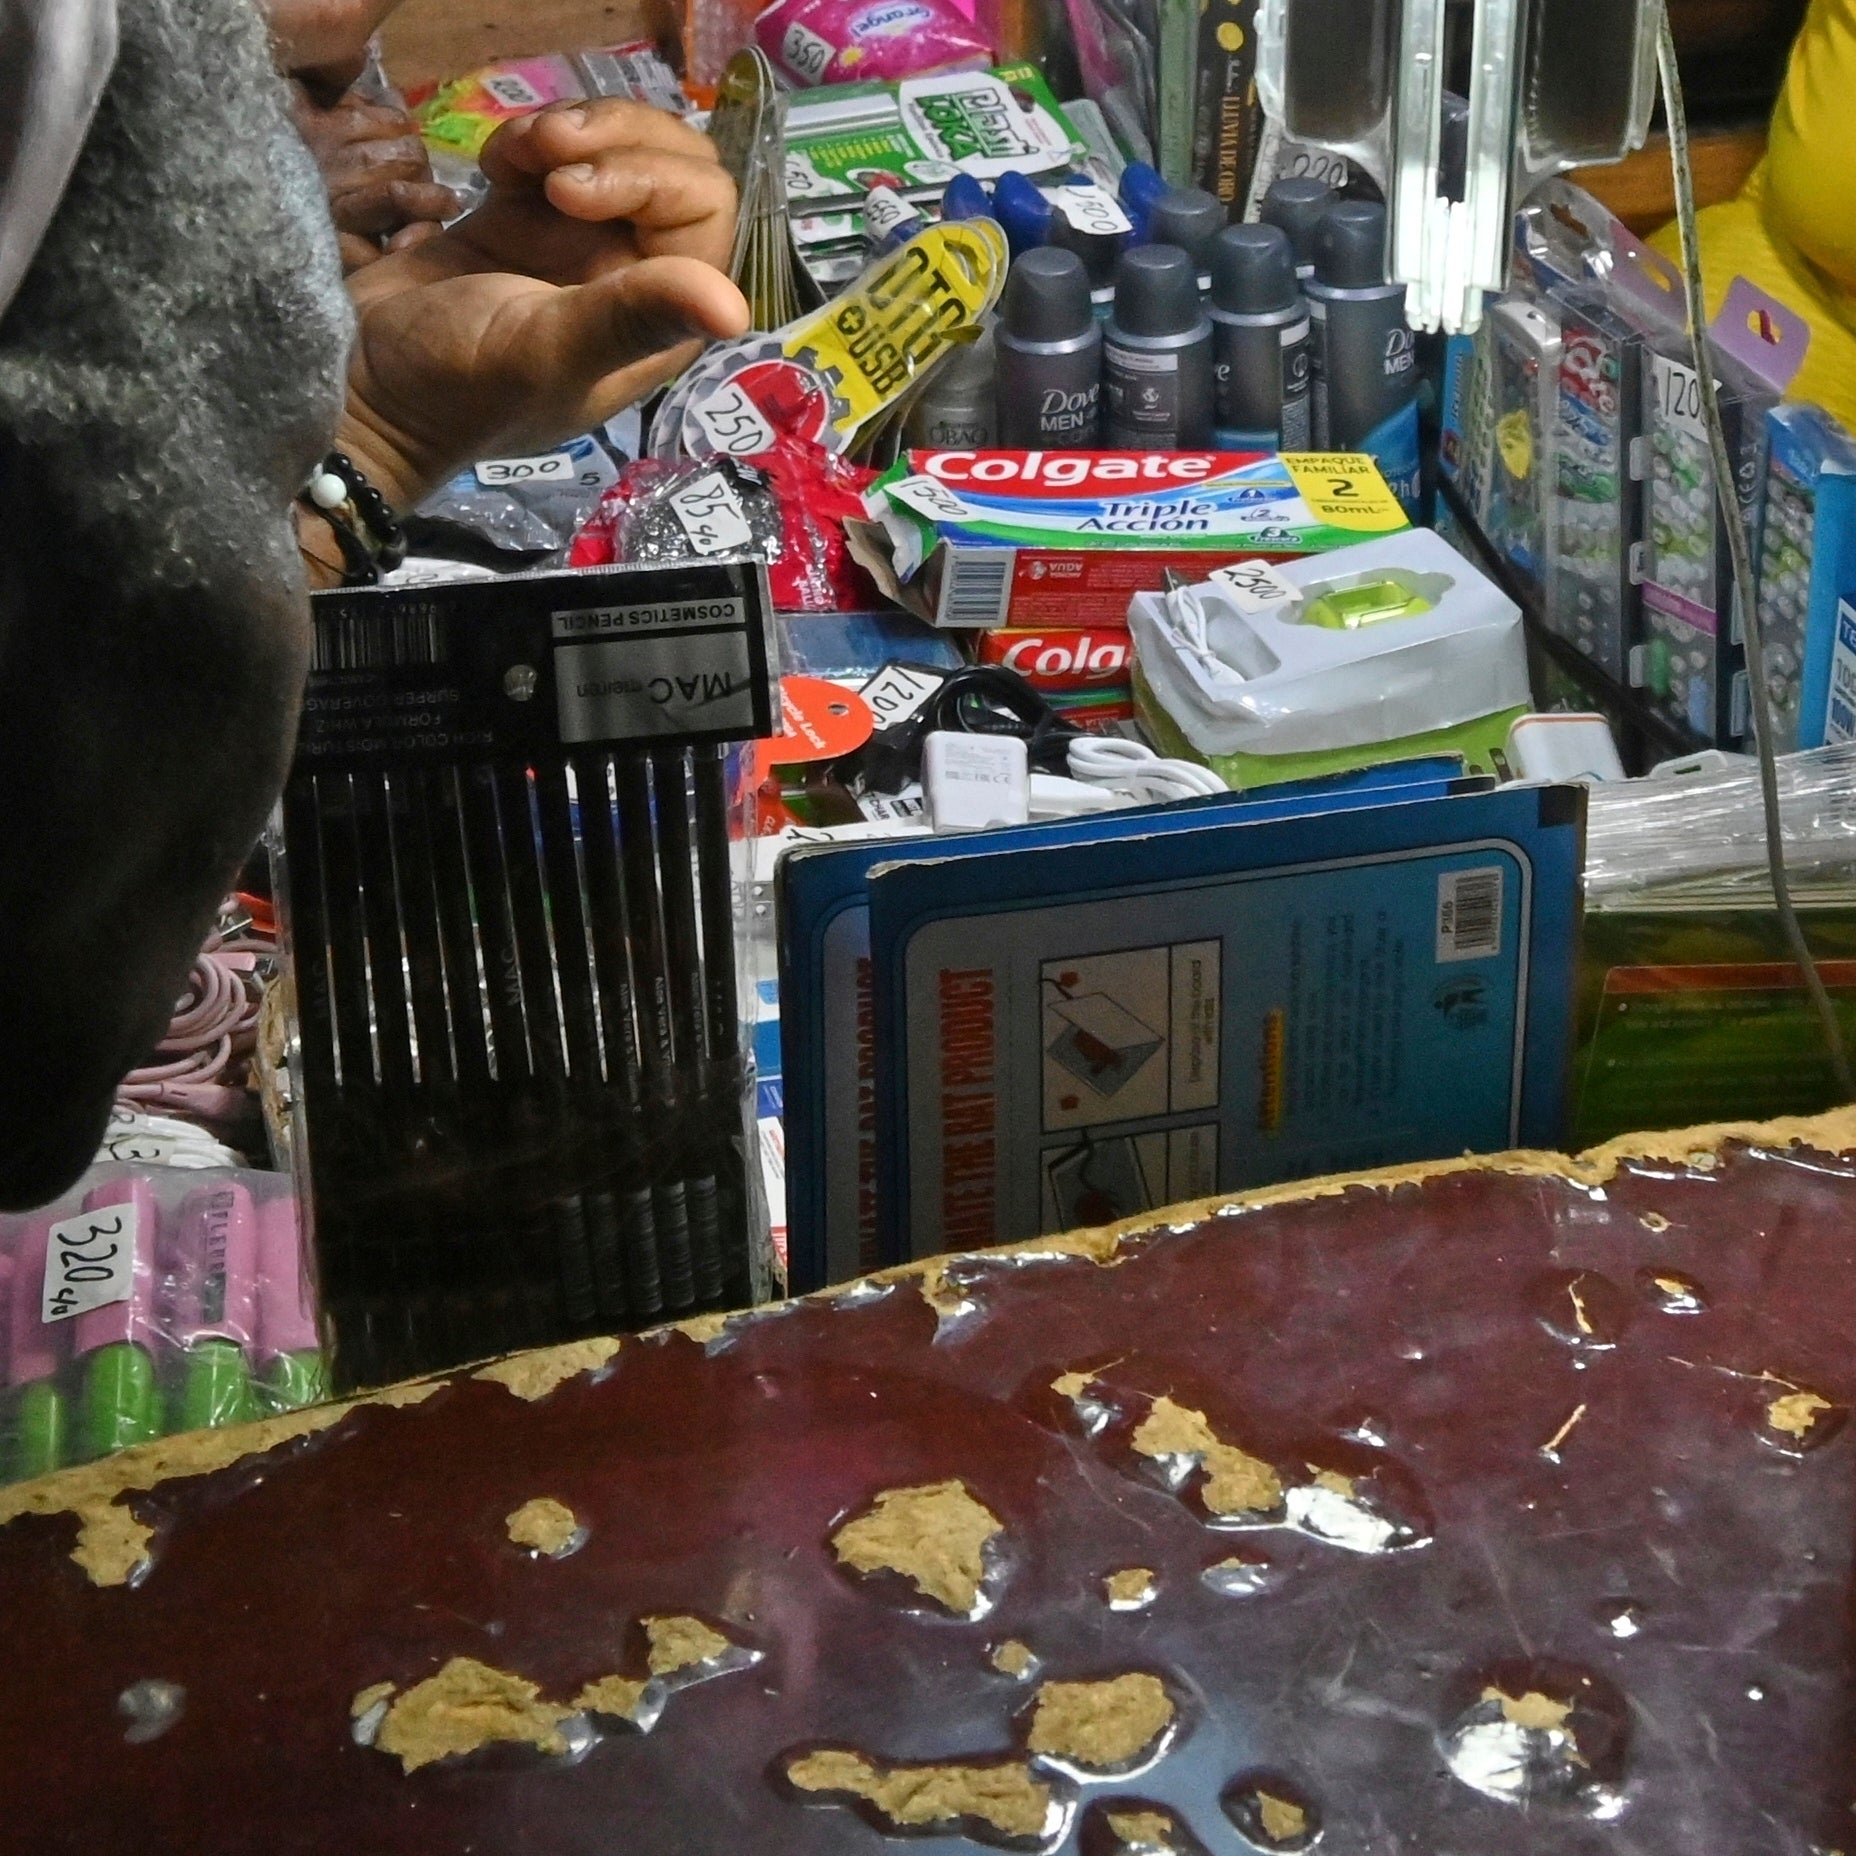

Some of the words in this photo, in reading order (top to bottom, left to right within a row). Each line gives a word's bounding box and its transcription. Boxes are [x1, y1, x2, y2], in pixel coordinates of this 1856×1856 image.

[787, 29, 826, 74] 350
[864, 246, 967, 366] OTG
[848, 334, 906, 395] USB
[1041, 383, 1100, 416] Dove
[1665, 366, 1710, 425] 120
[704, 392, 763, 453] 250
[1040, 412, 1084, 431] MEN
[486, 460, 561, 480] 300
[925, 450, 1212, 487] Colgate
[1285, 456, 1364, 466] EMPAQUE
[1292, 465, 1371, 475] FAMILIAR
[679, 484, 740, 520] 85
[900, 480, 968, 516] 1500
[1326, 479, 1359, 497] 2
[1076, 517, 1208, 532] Acción
[1104, 499, 1212, 519] Triple
[1223, 567, 1287, 600] 2500
[557, 610, 625, 632] PENCIL
[627, 603, 736, 629] COSMETICS
[1002, 636, 1132, 680] Colg
[647, 670, 737, 705] MAC
[939, 967, 995, 1087] PRODUCT
[940, 1091, 995, 1137] RAT
[56, 1215, 123, 1283] 320
